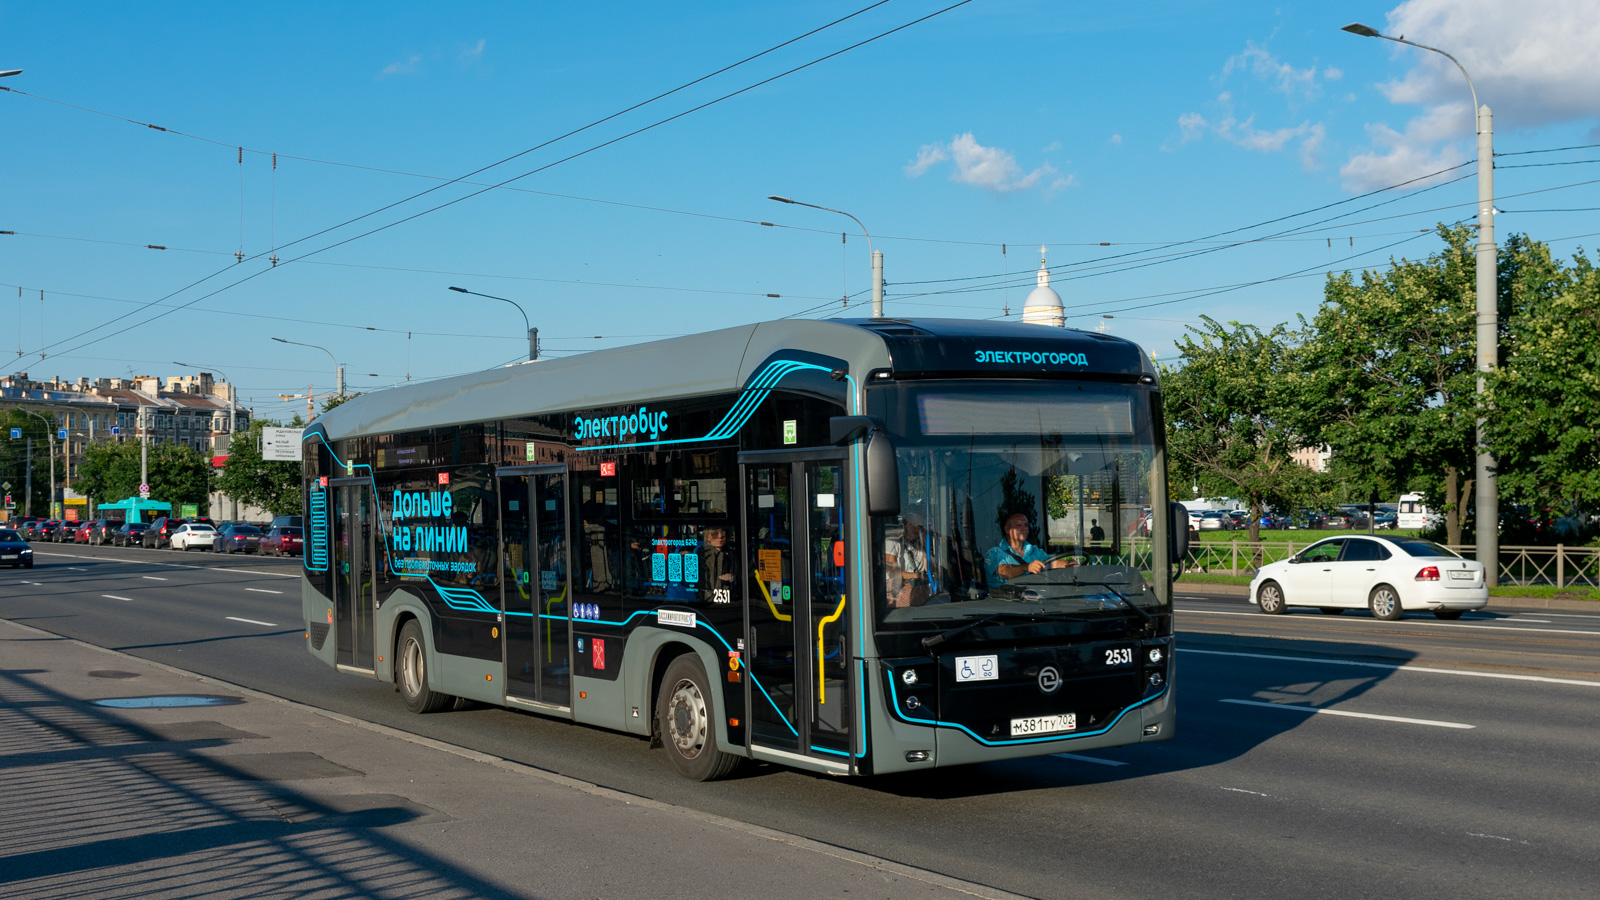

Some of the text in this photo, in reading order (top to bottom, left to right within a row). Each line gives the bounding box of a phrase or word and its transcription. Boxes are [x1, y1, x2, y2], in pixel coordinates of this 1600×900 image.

[974, 350, 1088, 366] ЭЛЕКТРОГОРОД
[574, 407, 668, 441] Электробус
[392, 489, 453, 521] Дольше
[393, 526, 468, 553] на линии
[394, 557, 477, 574] без промежуточных зарядок
[713, 589, 731, 604] 2531
[1105, 648, 1133, 665] 2531
